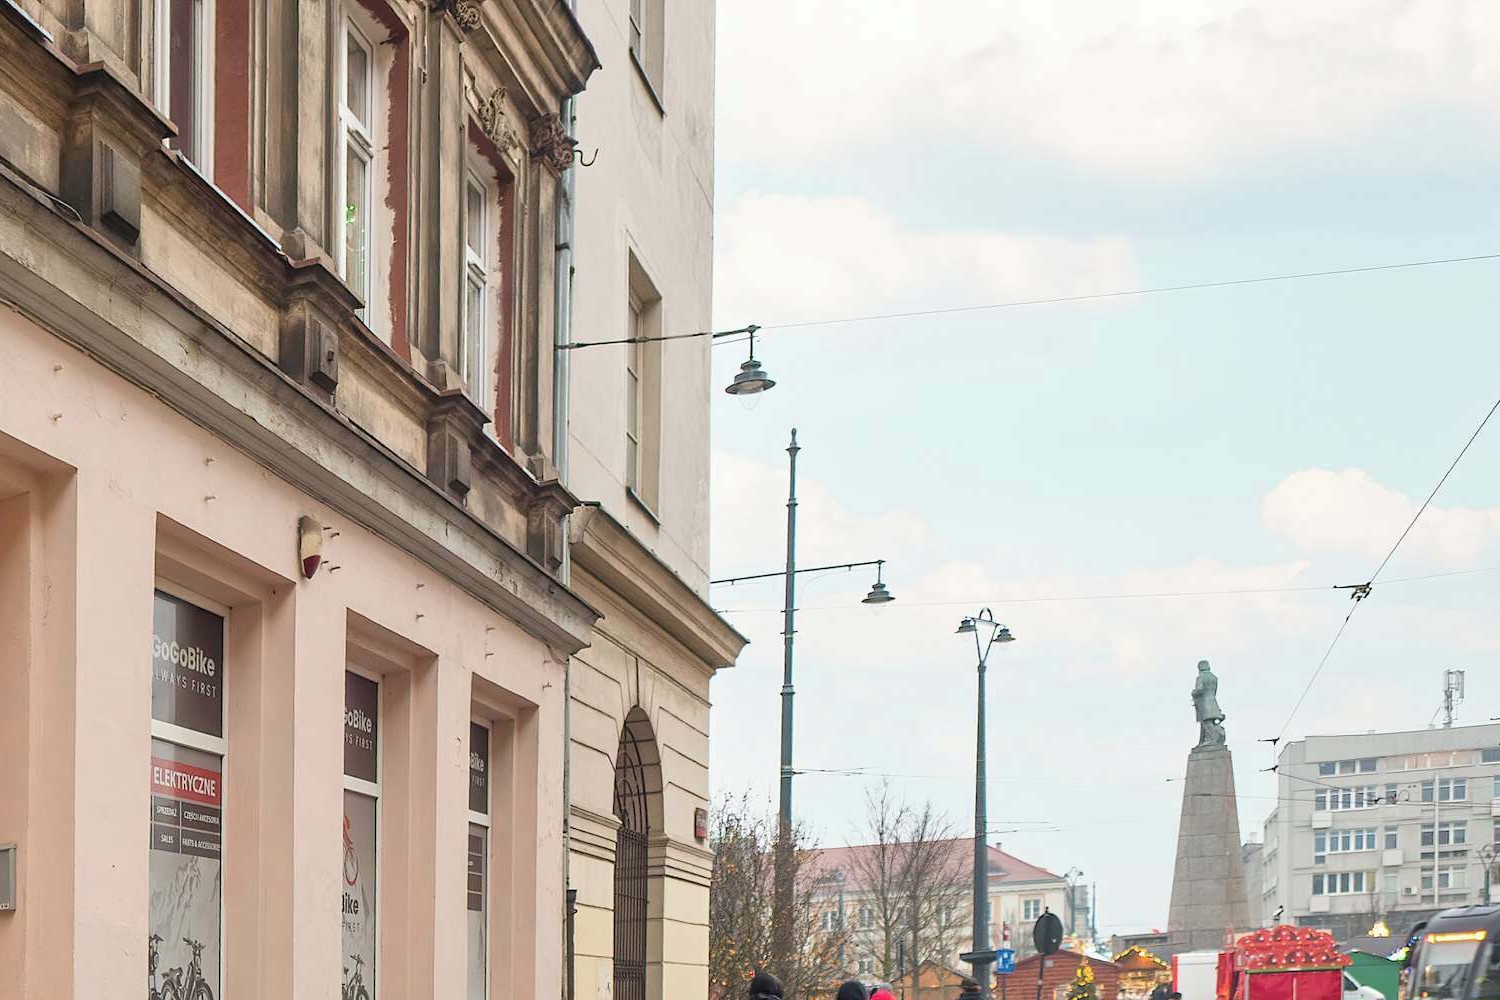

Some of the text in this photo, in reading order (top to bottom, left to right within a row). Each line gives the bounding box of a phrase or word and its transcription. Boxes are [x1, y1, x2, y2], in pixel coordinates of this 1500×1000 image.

[192, 679, 216, 698] FIRST
[356, 735, 373, 751] FIRST
[154, 766, 216, 797] ELEKTRYCZNE
